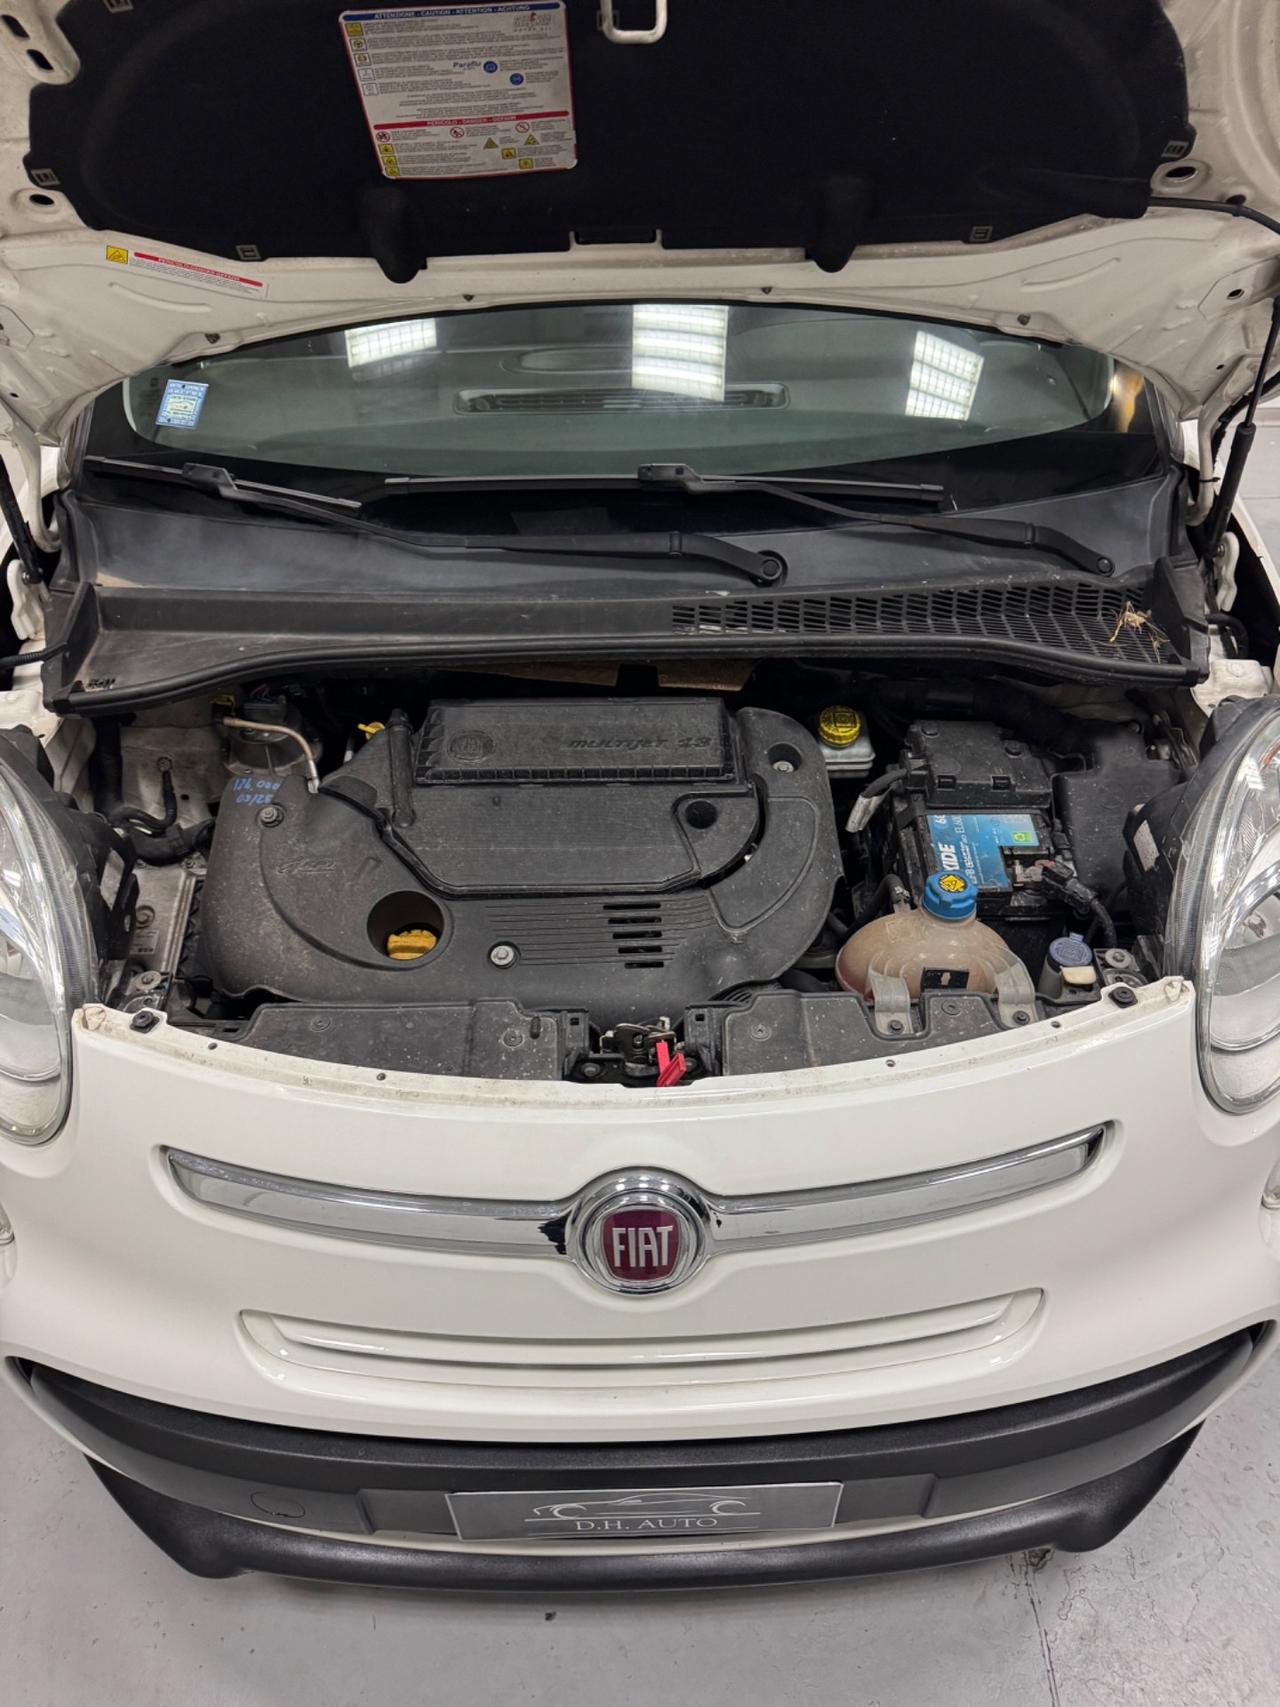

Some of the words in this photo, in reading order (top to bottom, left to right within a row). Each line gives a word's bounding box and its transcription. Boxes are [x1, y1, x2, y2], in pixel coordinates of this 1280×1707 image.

[420, 9, 451, 17] CAUTION
[455, 7, 493, 15] ATTENTION
[497, 5, 530, 13] ACHTUNG
[938, 841, 960, 870] XIDE
[611, 1225, 674, 1268] FIAT
[574, 1519, 632, 1531] D.H.
[638, 1517, 718, 1529] AUTO
